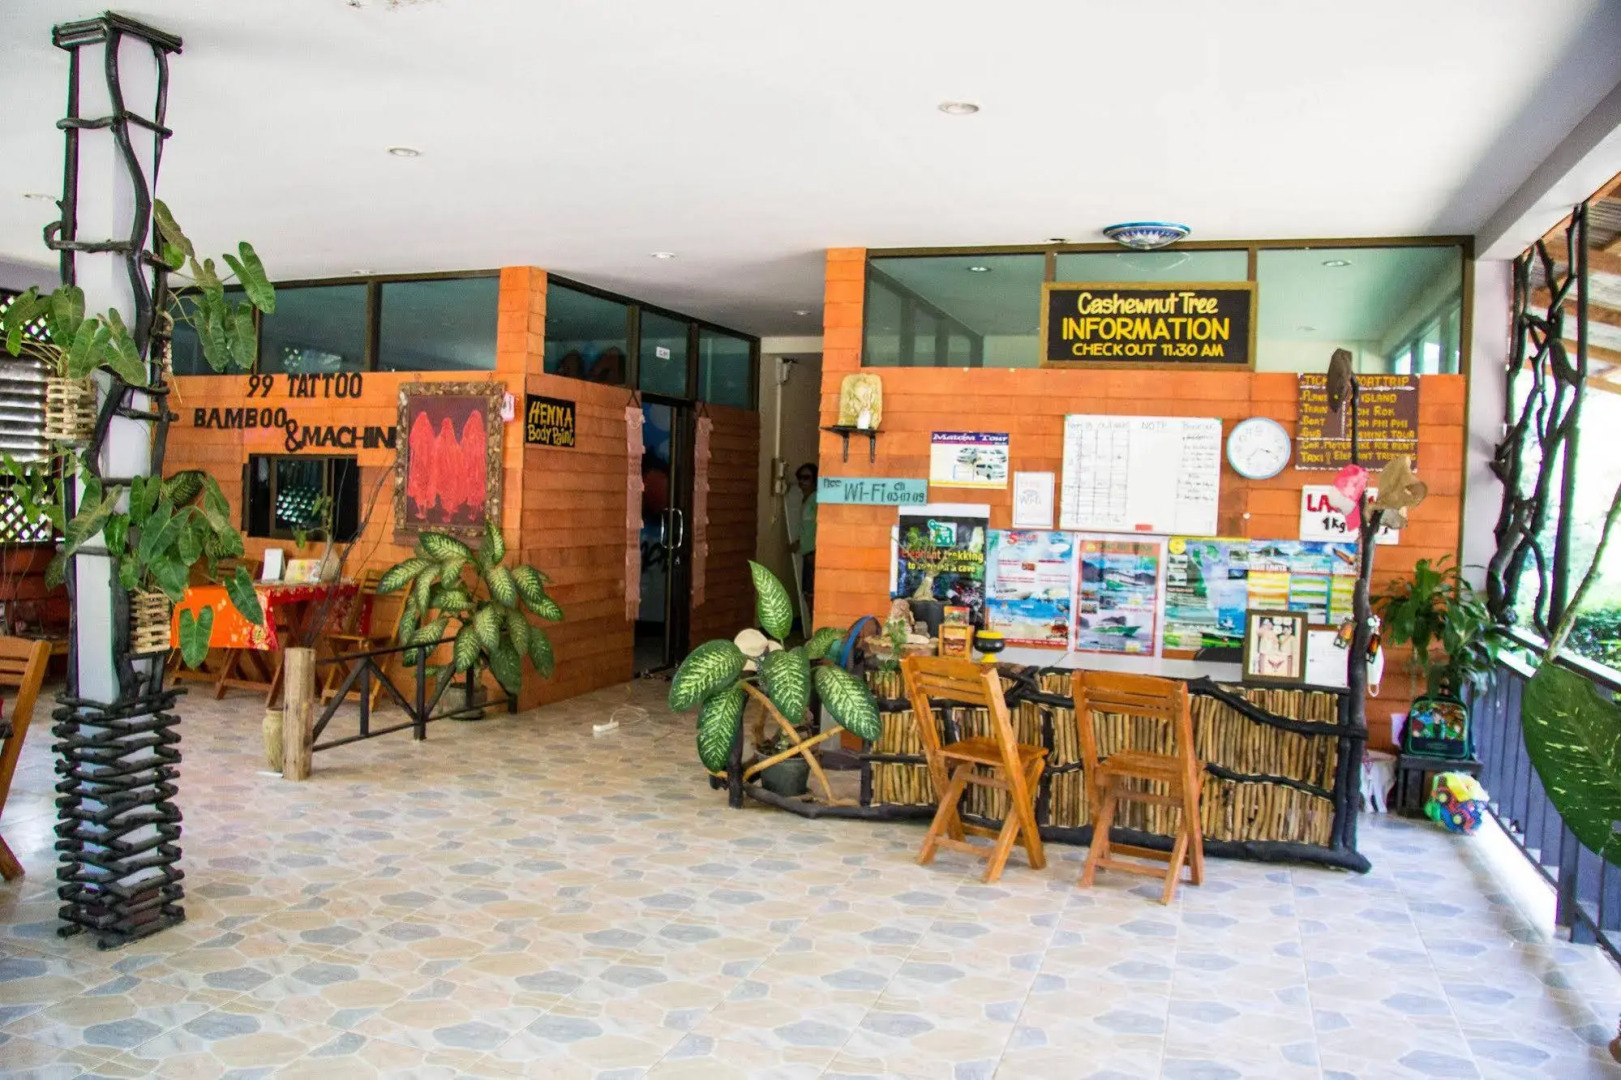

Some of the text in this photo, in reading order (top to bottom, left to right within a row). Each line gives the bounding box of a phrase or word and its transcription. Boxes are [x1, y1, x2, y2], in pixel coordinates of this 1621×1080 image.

[1077, 292, 1219, 315] Cashewnut Tree
[1062, 317, 1231, 341] INFORMATION
[1200, 345, 1224, 357] AM
[247, 373, 363, 399] 99 TATTOO
[1360, 393, 1397, 404] ISLAND
[194, 407, 288, 429] BAMBOO
[528, 401, 573, 428] HENNA
[1303, 415, 1326, 426] BOAT
[528, 424, 574, 446] Body Paint
[1300, 451, 1323, 462] TAXI
[844, 482, 886, 502] Wi-Fi
